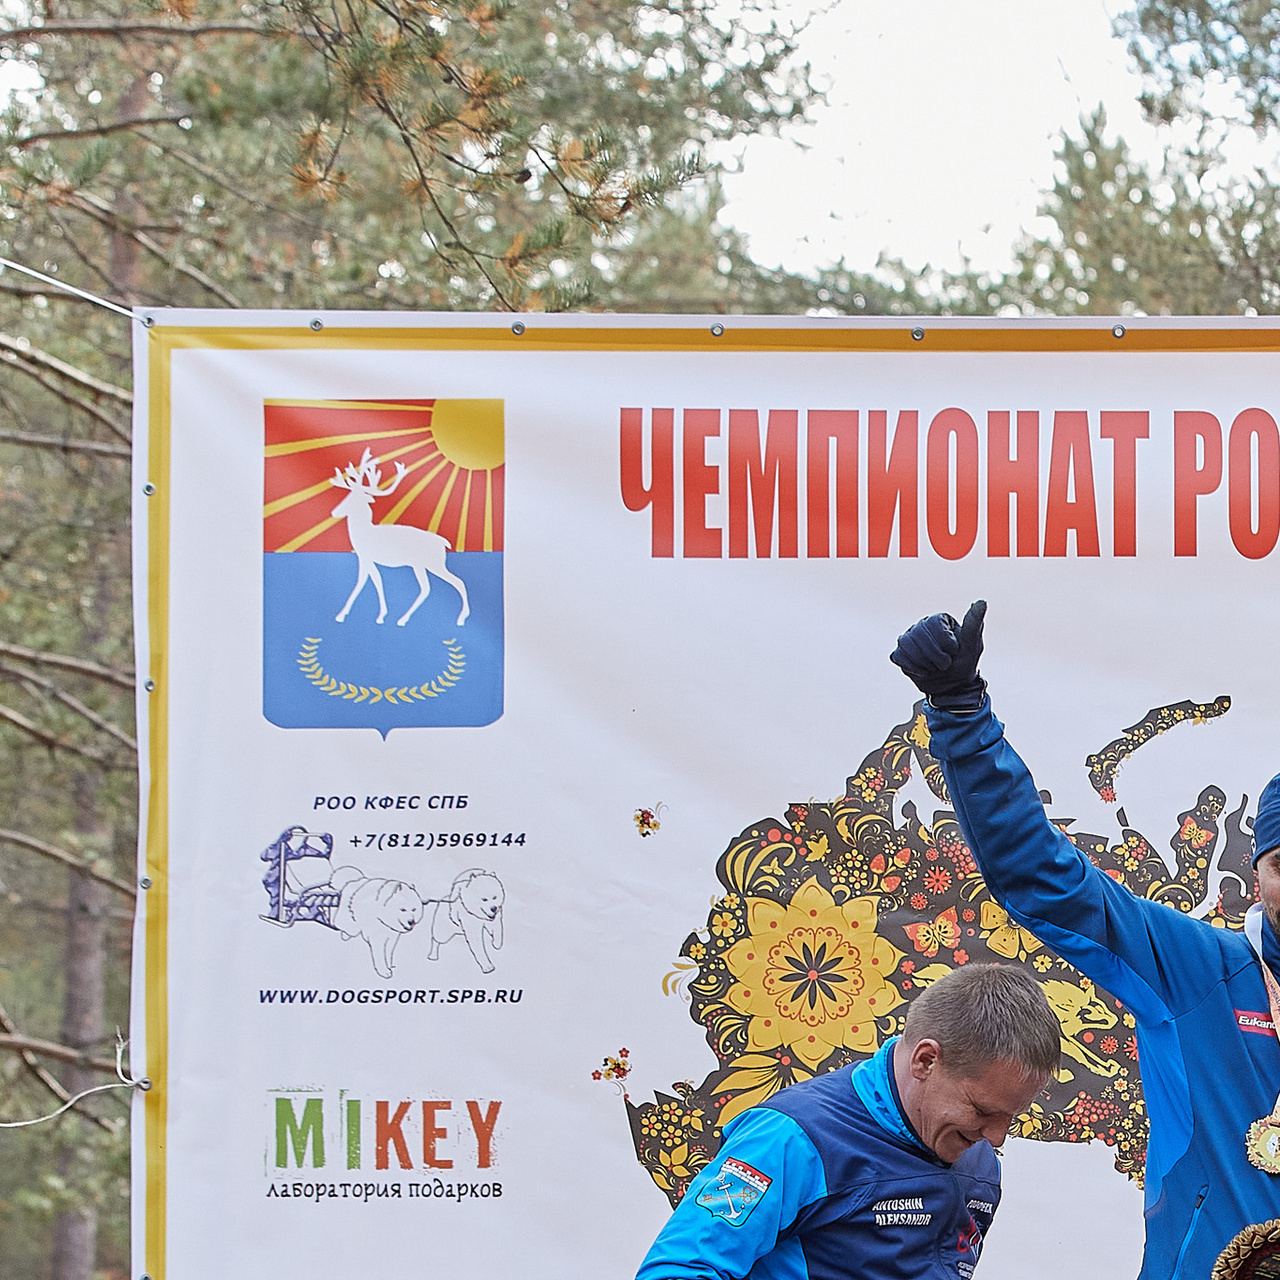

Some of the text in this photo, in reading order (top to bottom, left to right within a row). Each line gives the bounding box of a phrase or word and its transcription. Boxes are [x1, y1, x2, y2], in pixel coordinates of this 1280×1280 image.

[620, 407, 1151, 561] ЧЕМПИОНАТ
[313, 795, 469, 811] РОО КФЕС СПБ
[349, 832, 527, 852] +7(812)5969144
[259, 988, 523, 1006] WWW.DOGSPORT.SPB.RU
[271, 1096, 503, 1171] MIKEY
[266, 1181, 503, 1203] лаборатория подарков
[872, 1197, 924, 1211] ANTOSHIN
